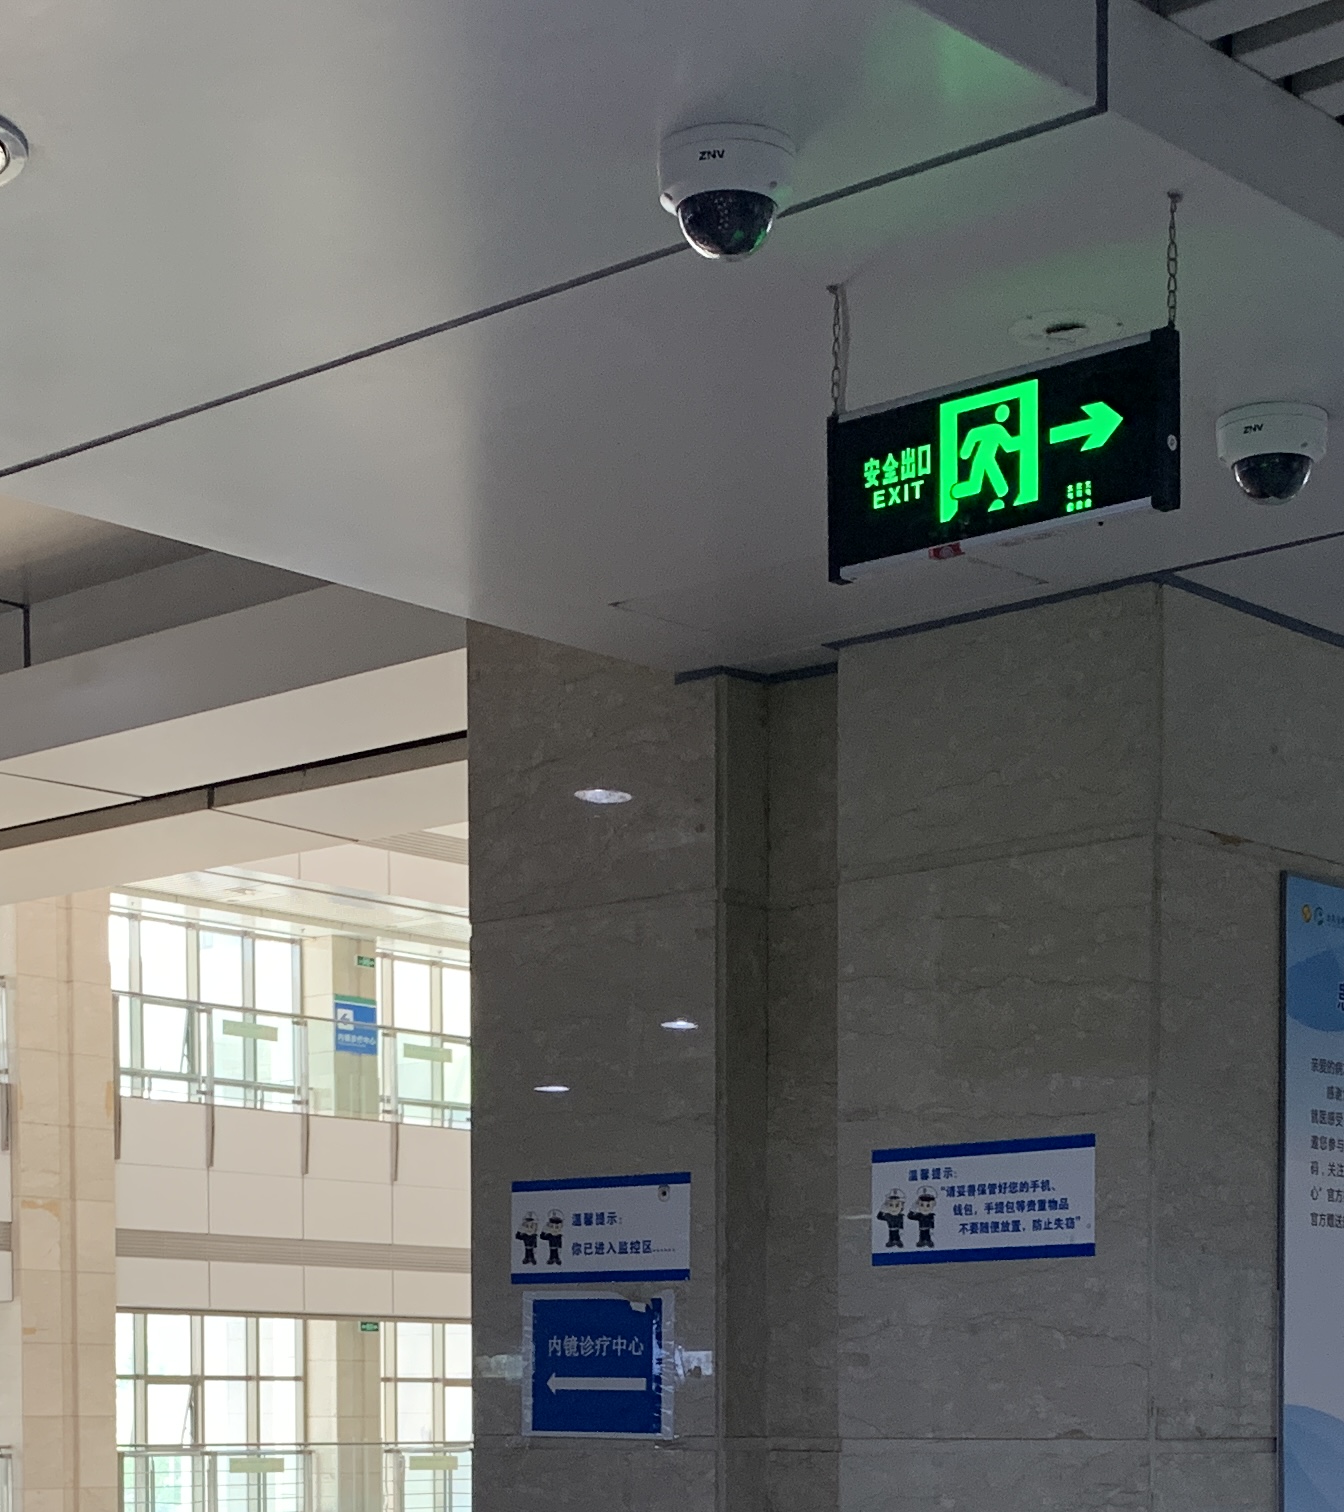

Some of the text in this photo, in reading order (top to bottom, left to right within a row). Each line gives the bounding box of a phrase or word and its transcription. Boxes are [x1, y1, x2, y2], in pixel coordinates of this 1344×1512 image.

[698, 149, 725, 161] ZNV
[863, 443, 931, 489] 安全出口
[872, 480, 925, 510] EXIT
[547, 1335, 644, 1357] 内镜诊疗中心
